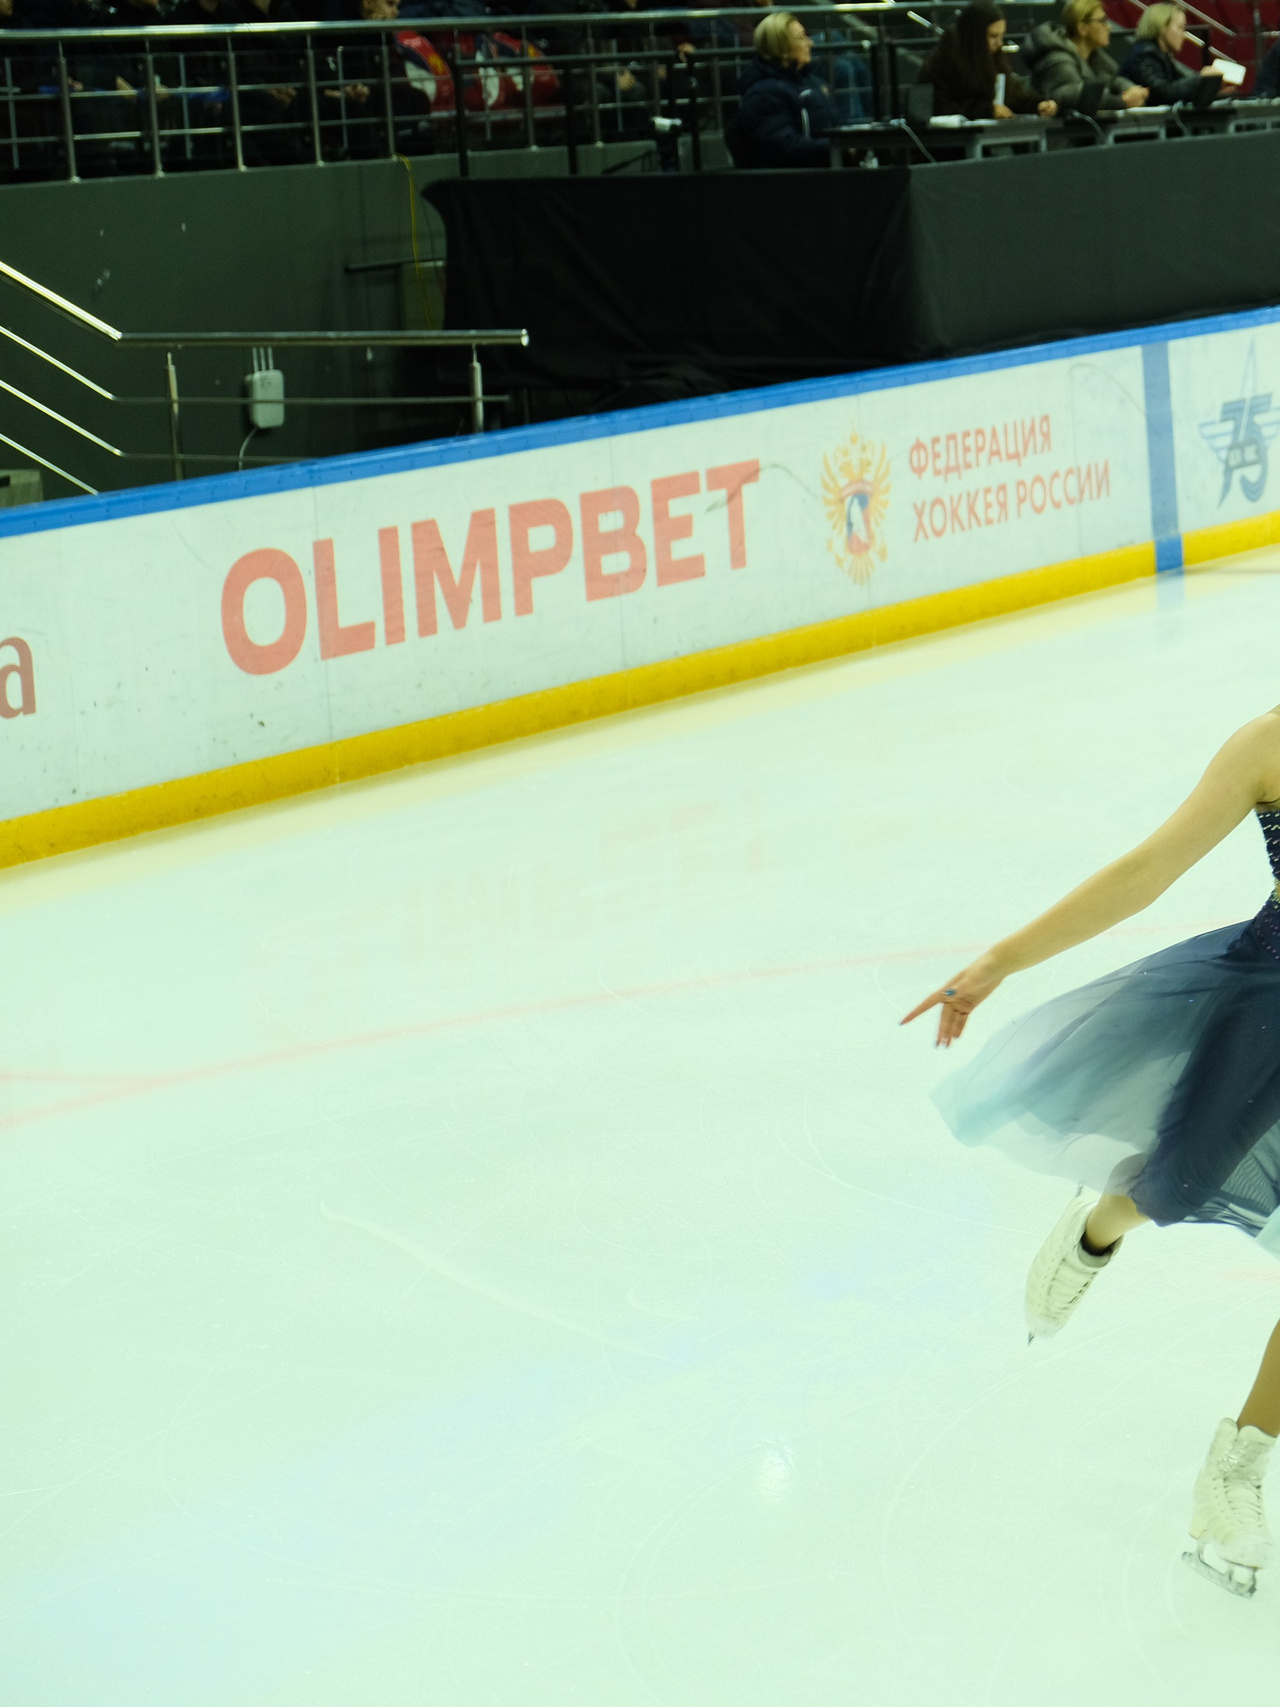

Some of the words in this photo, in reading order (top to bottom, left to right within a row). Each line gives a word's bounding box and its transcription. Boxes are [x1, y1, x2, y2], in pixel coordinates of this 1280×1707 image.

[908, 413, 1052, 483] ФЕДЕРАЦИЯ
[913, 483, 1009, 543] ХОККЕЯ
[1017, 459, 1111, 516] РОССИИ
[220, 459, 760, 675] OLIMPBET
